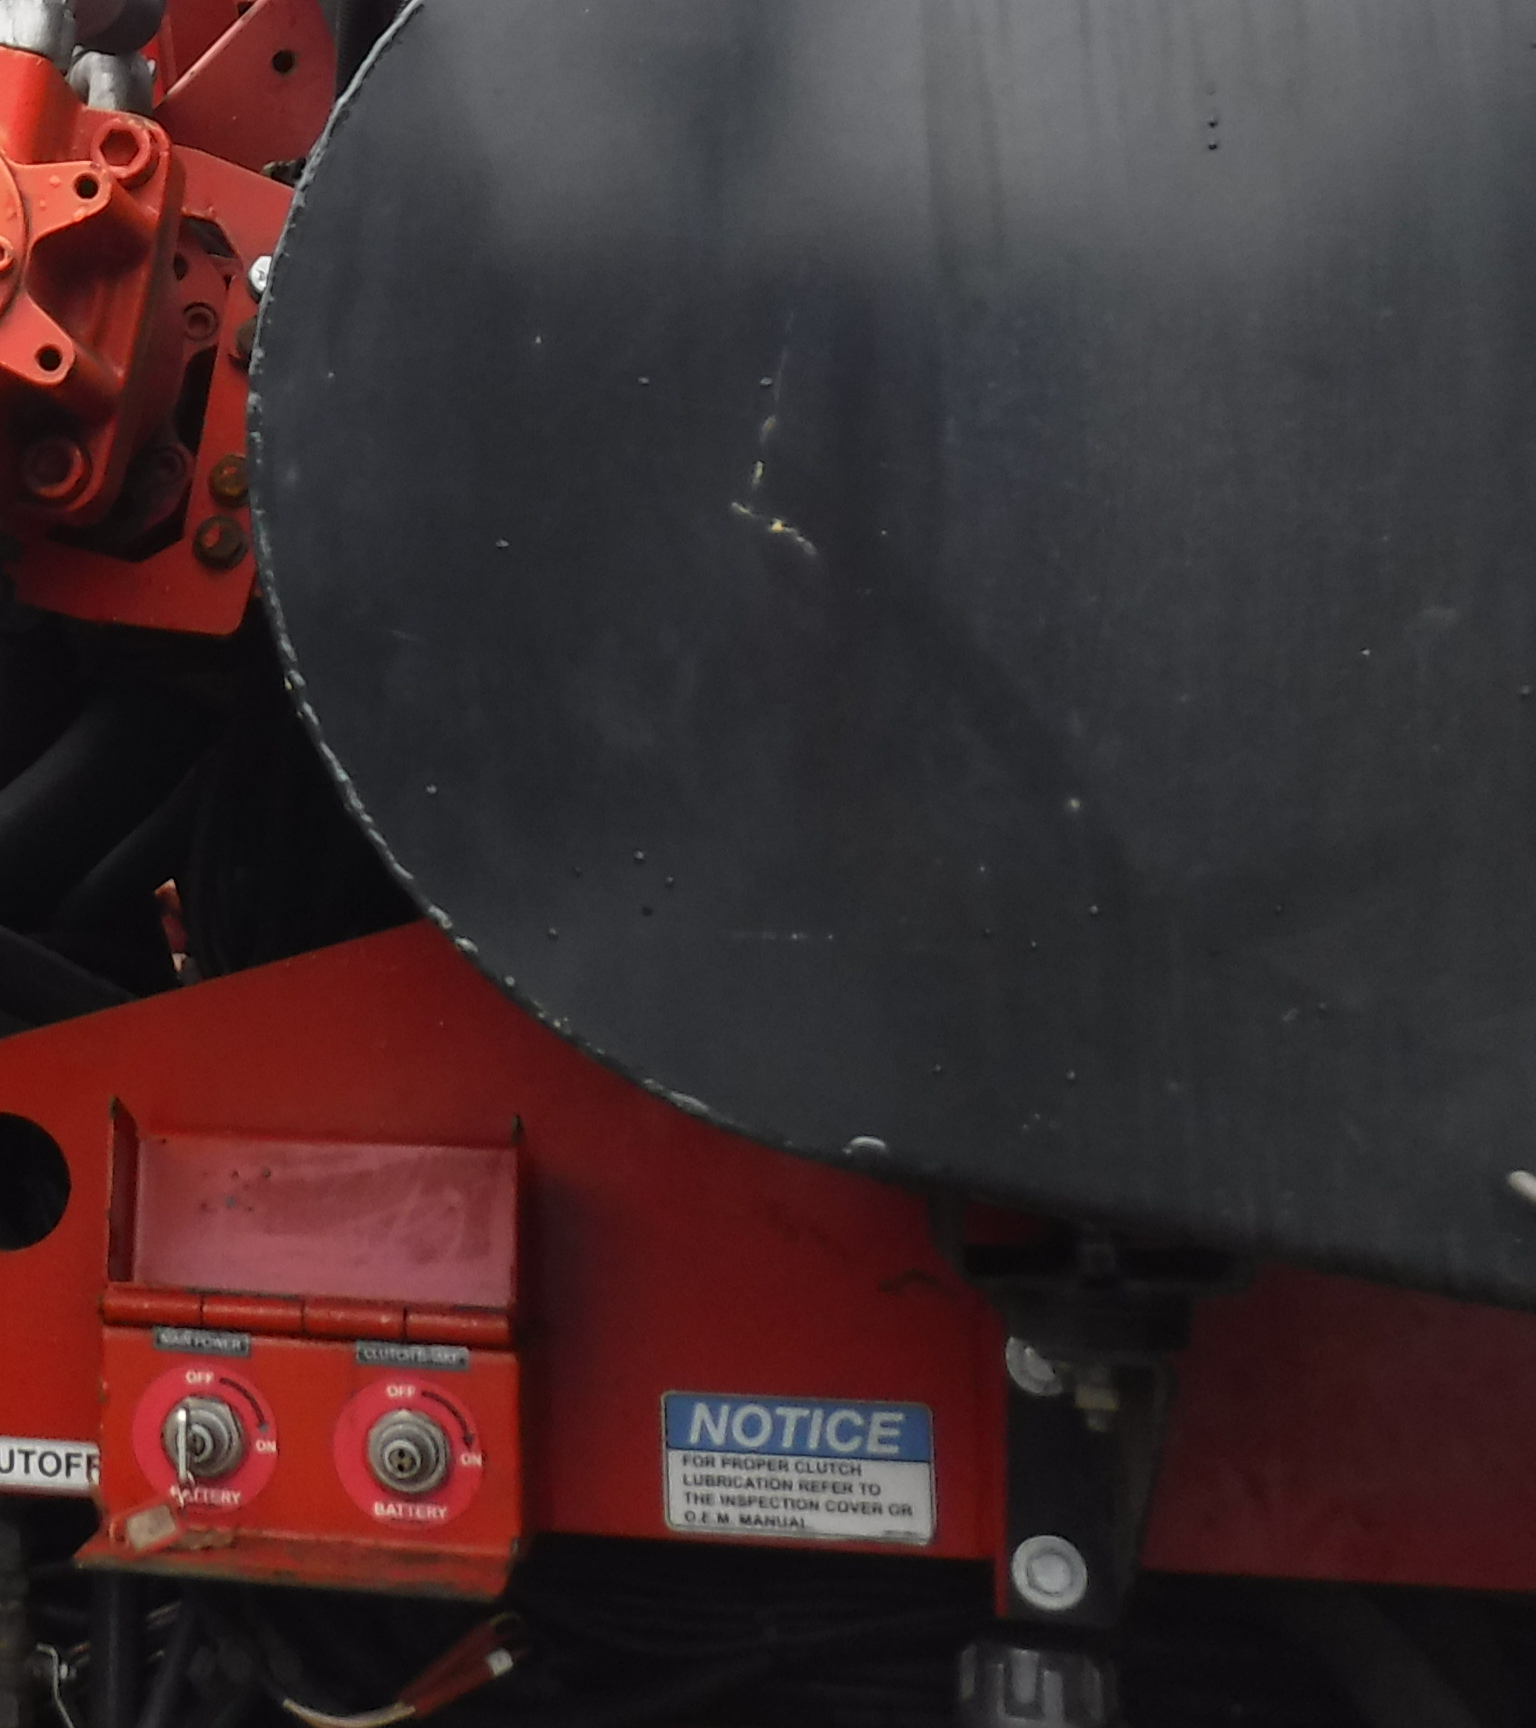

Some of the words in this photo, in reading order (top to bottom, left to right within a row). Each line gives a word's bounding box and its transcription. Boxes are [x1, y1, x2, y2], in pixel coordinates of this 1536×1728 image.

[185, 1370, 215, 1385] OFF
[386, 1383, 417, 1398] OFF
[688, 1402, 905, 1455] NOTICE
[255, 1439, 277, 1453] ON
[460, 1452, 483, 1467] ON
[682, 1455, 717, 1468] FOR
[721, 1457, 790, 1472] PROPER
[794, 1461, 862, 1477] CLUTCH
[682, 1475, 794, 1491] LUBRICATION
[798, 1480, 854, 1495] REFER
[859, 1482, 882, 1497] TO
[374, 1501, 448, 1520] BATTERY
[684, 1492, 714, 1506] THE
[719, 1494, 820, 1511] INSPECTION
[824, 1500, 884, 1516] COVER
[888, 1503, 914, 1518] OR
